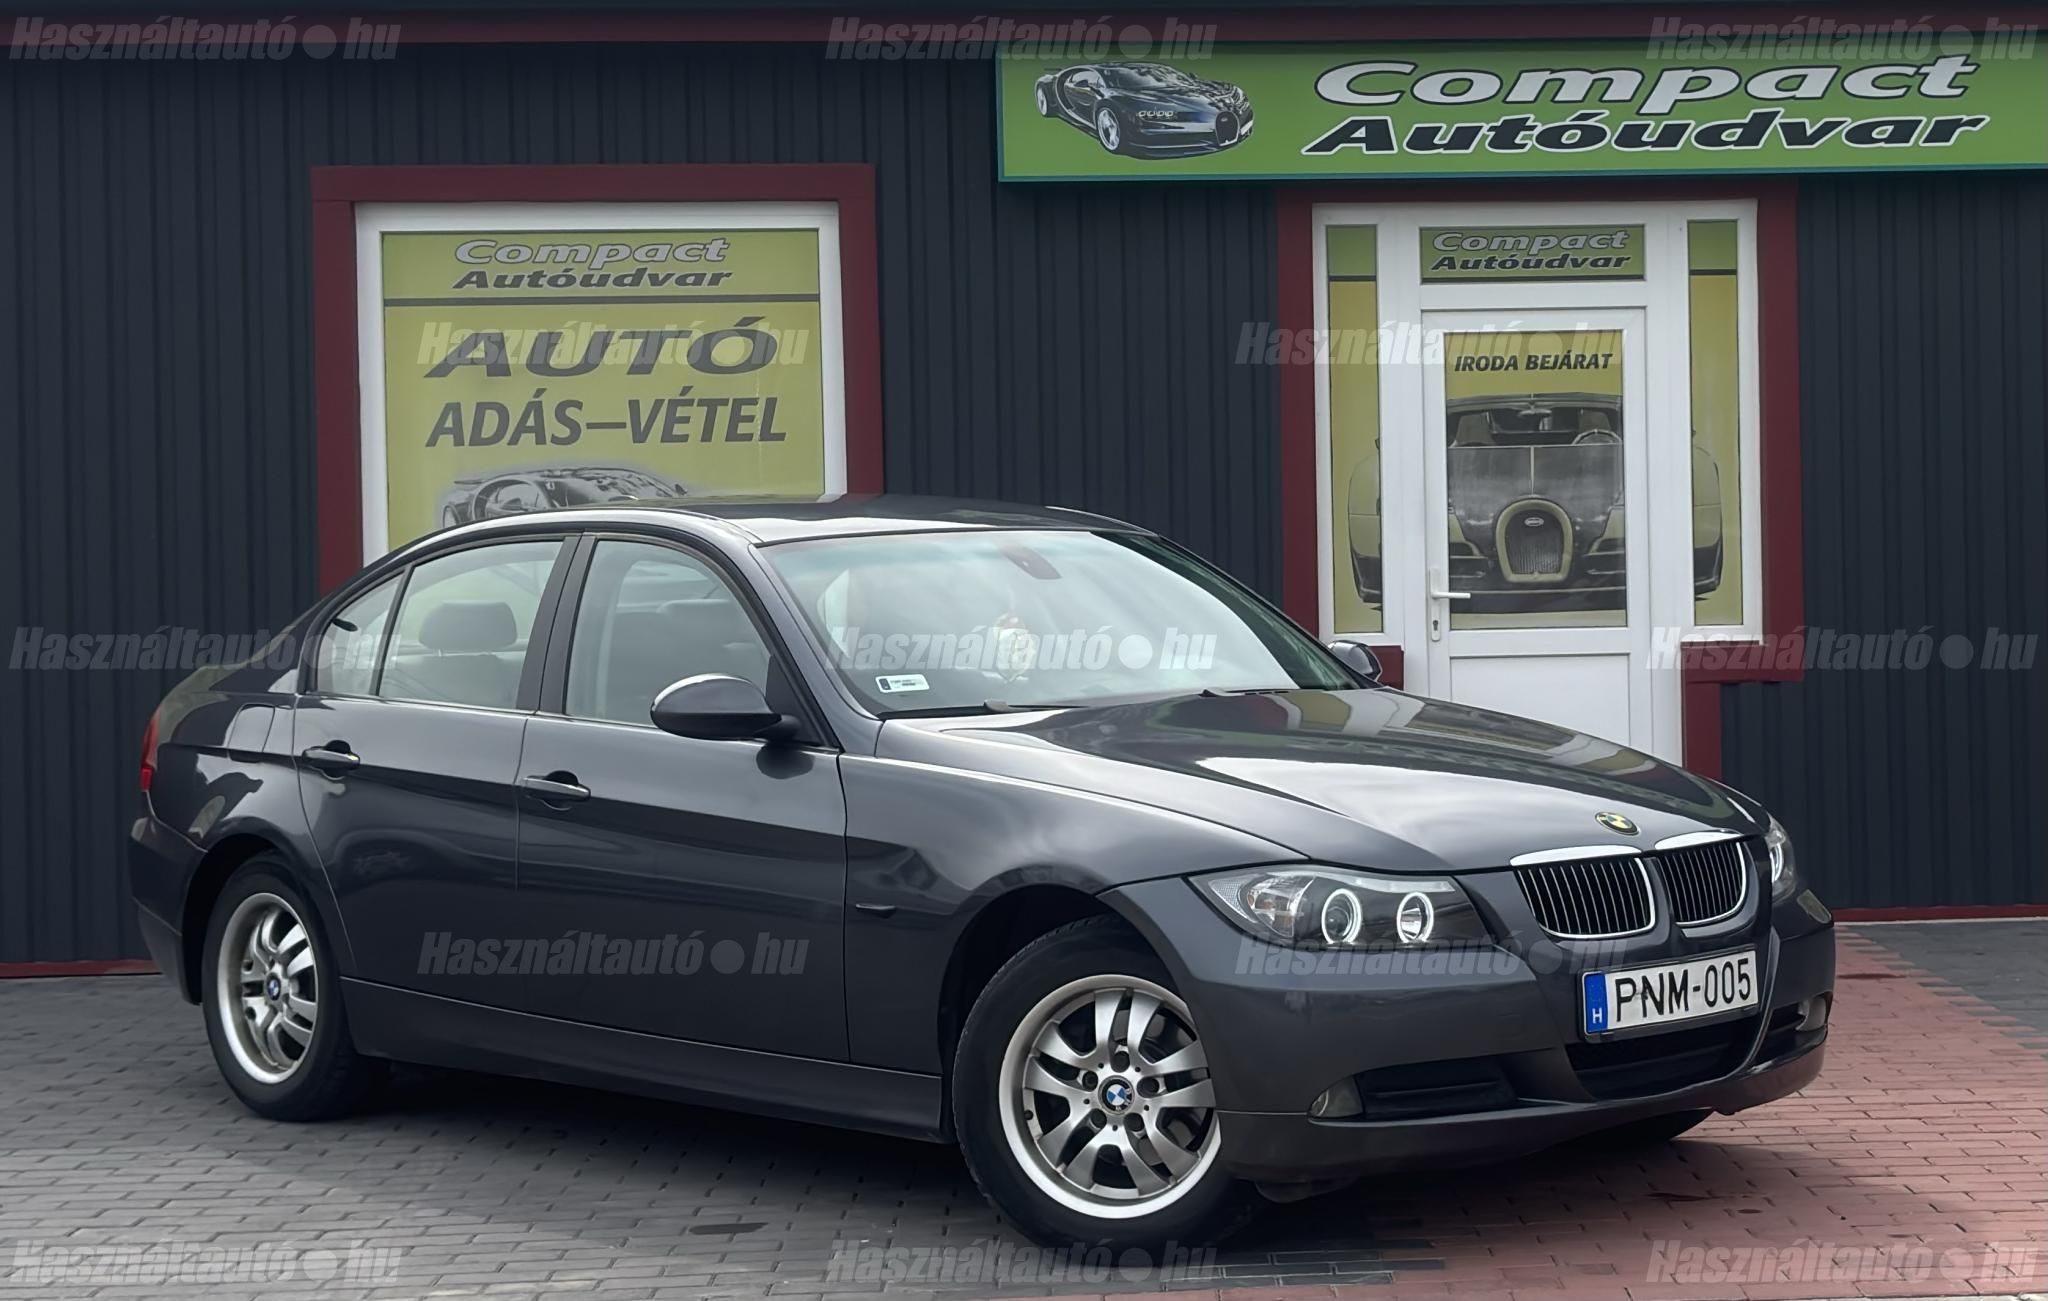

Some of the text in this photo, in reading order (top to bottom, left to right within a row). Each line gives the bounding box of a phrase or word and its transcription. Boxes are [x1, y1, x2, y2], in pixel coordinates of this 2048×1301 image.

[1315, 54, 1980, 117] Compact
[1301, 107, 1990, 156] Autóudvar
[455, 237, 731, 270] Compact
[1432, 229, 1631, 255] Compact
[1430, 251, 1632, 272] Autóudvar
[452, 267, 733, 289] Autóudvar
[424, 316, 778, 378] AUTÓ
[1455, 349, 1613, 372] IRODA BEJÁRAT
[1615, 958, 1751, 1022] PNM-005
[1592, 1008, 1603, 1024] H
